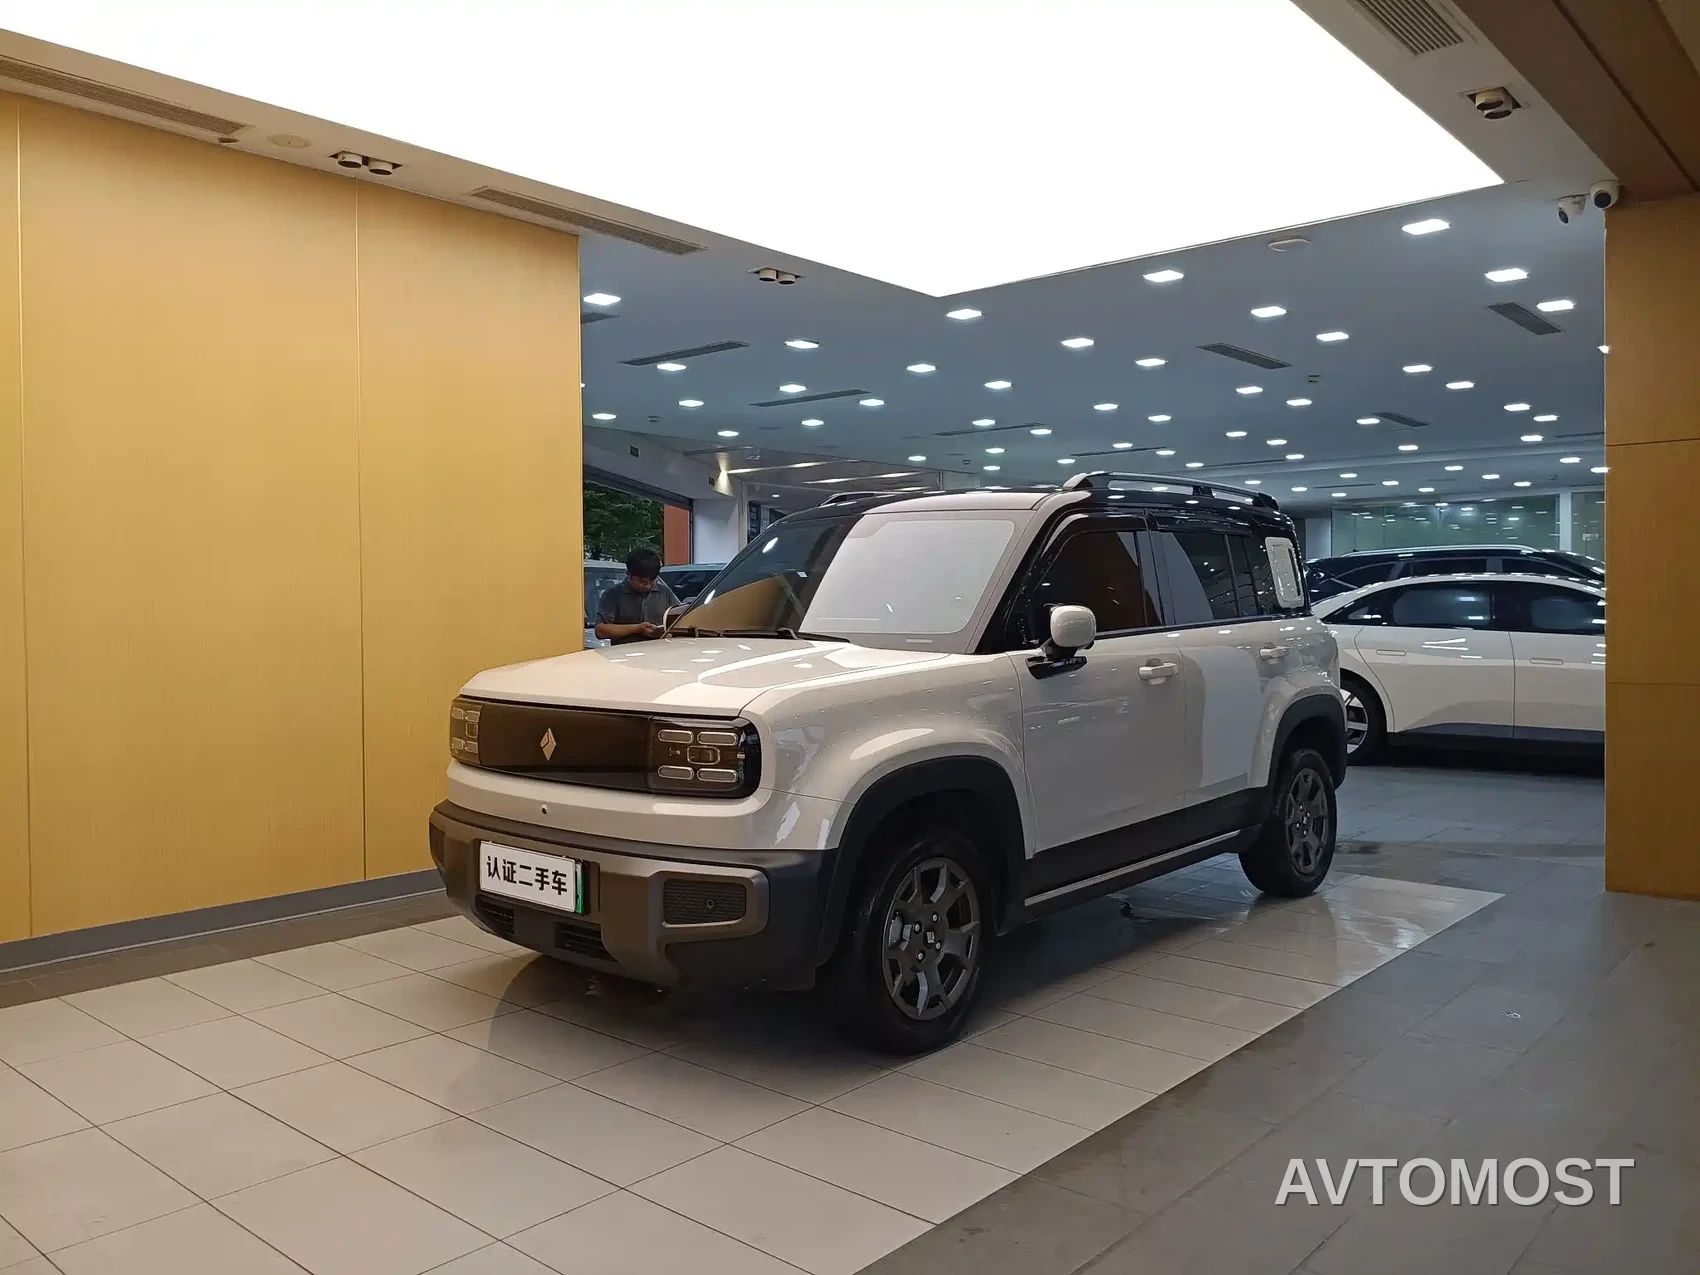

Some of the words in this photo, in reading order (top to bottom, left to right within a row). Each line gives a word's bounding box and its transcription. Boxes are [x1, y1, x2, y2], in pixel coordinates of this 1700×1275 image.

[487, 856, 567, 895] 认证二手车
